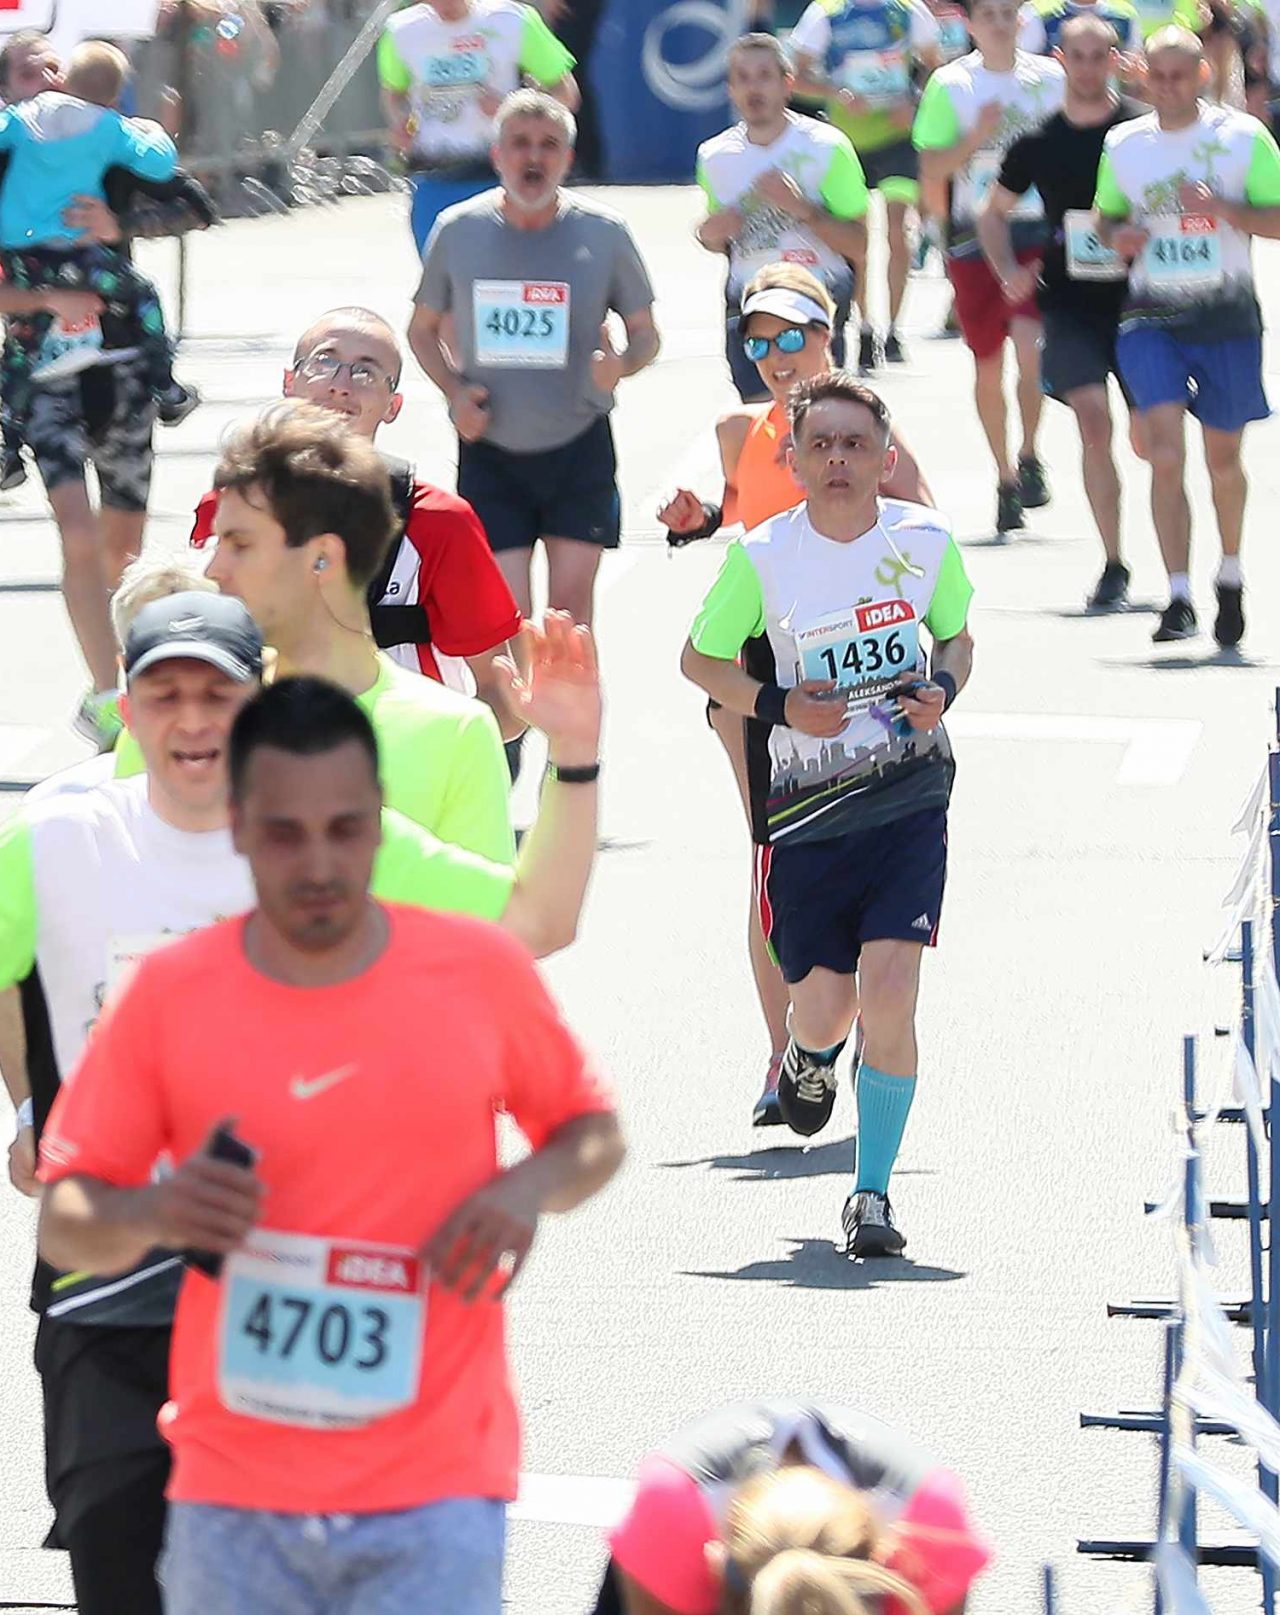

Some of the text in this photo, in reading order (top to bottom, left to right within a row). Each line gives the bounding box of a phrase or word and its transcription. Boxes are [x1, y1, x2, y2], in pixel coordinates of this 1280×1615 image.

[486, 308, 554, 336] 4025
[820, 631, 905, 680] 1436
[243, 1293, 390, 1370] 4703
